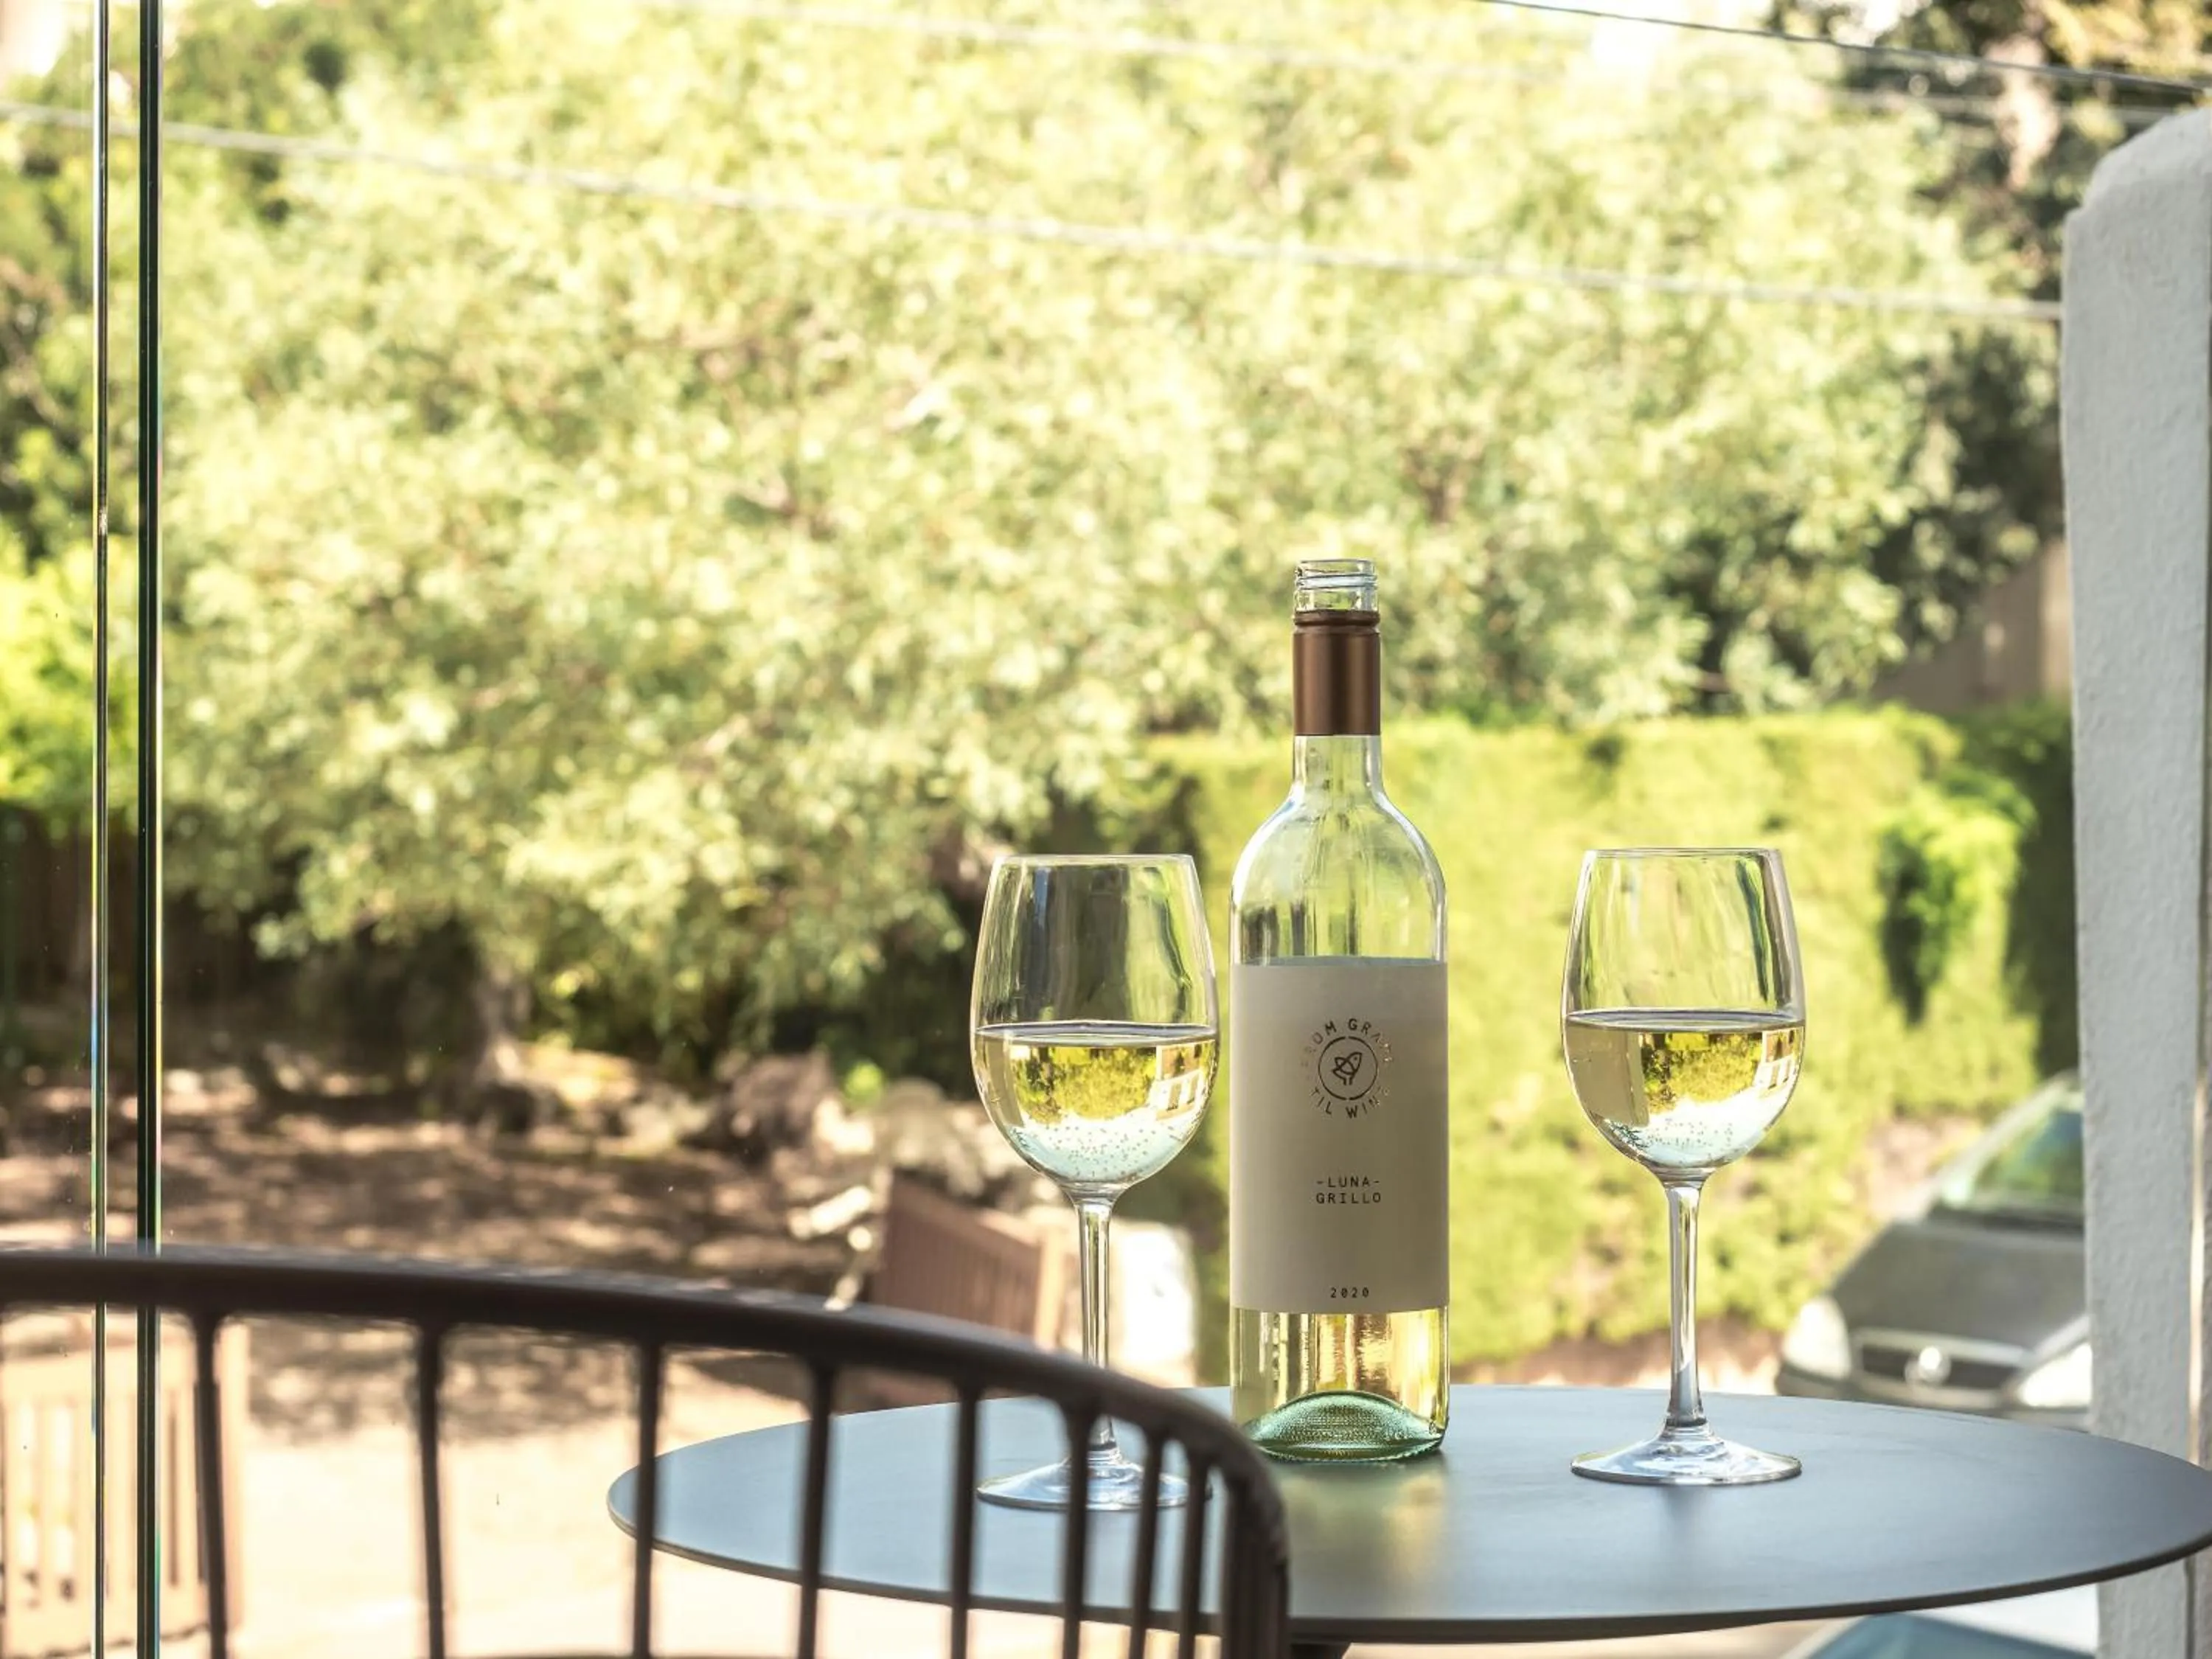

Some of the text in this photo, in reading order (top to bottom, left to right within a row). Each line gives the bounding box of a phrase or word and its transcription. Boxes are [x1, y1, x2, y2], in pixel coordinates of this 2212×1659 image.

[1301, 1020, 1338, 1068] OM
[1346, 1086, 1390, 1119] WIN
[1315, 1192, 1382, 1204] GRILLO
[1330, 1287, 1370, 1298] 2020
